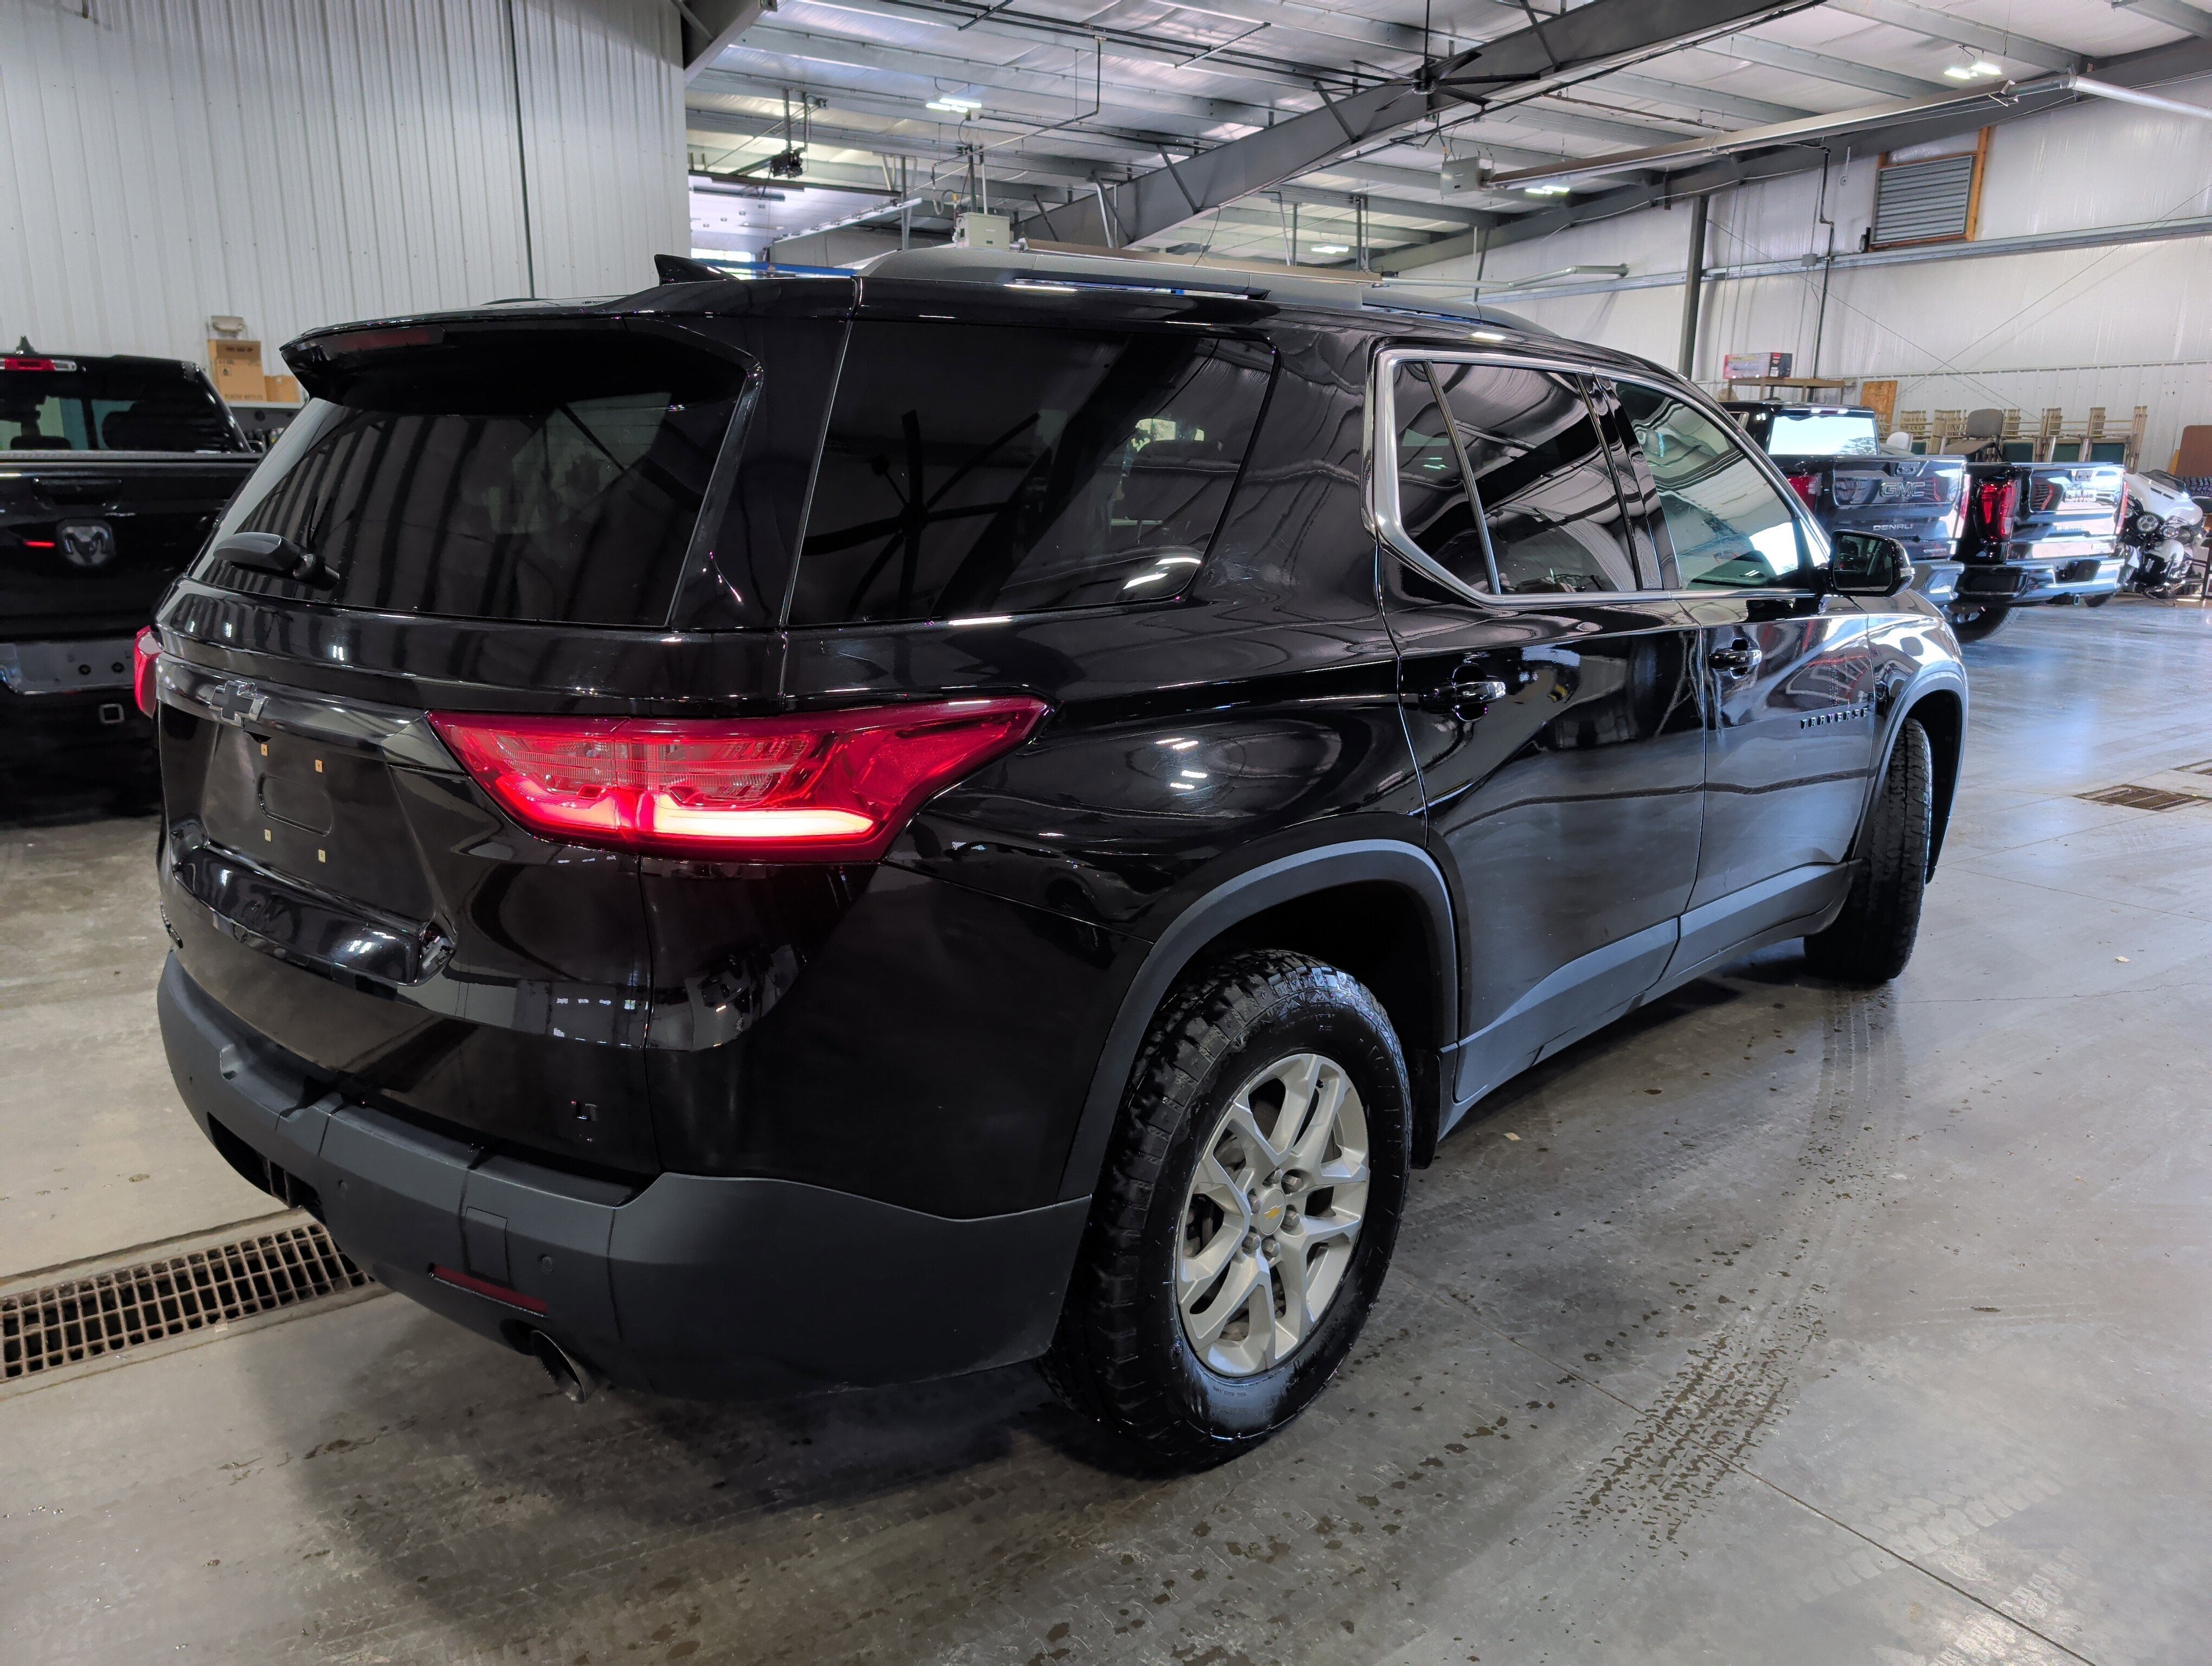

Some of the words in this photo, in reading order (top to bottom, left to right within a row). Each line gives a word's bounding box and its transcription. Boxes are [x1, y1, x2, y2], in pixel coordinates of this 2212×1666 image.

[1880, 481, 1925, 497] GMC
[2065, 489, 2097, 502] GMC
[1801, 708, 1868, 729] TRAVERSE
[571, 1100, 596, 1122] LT
